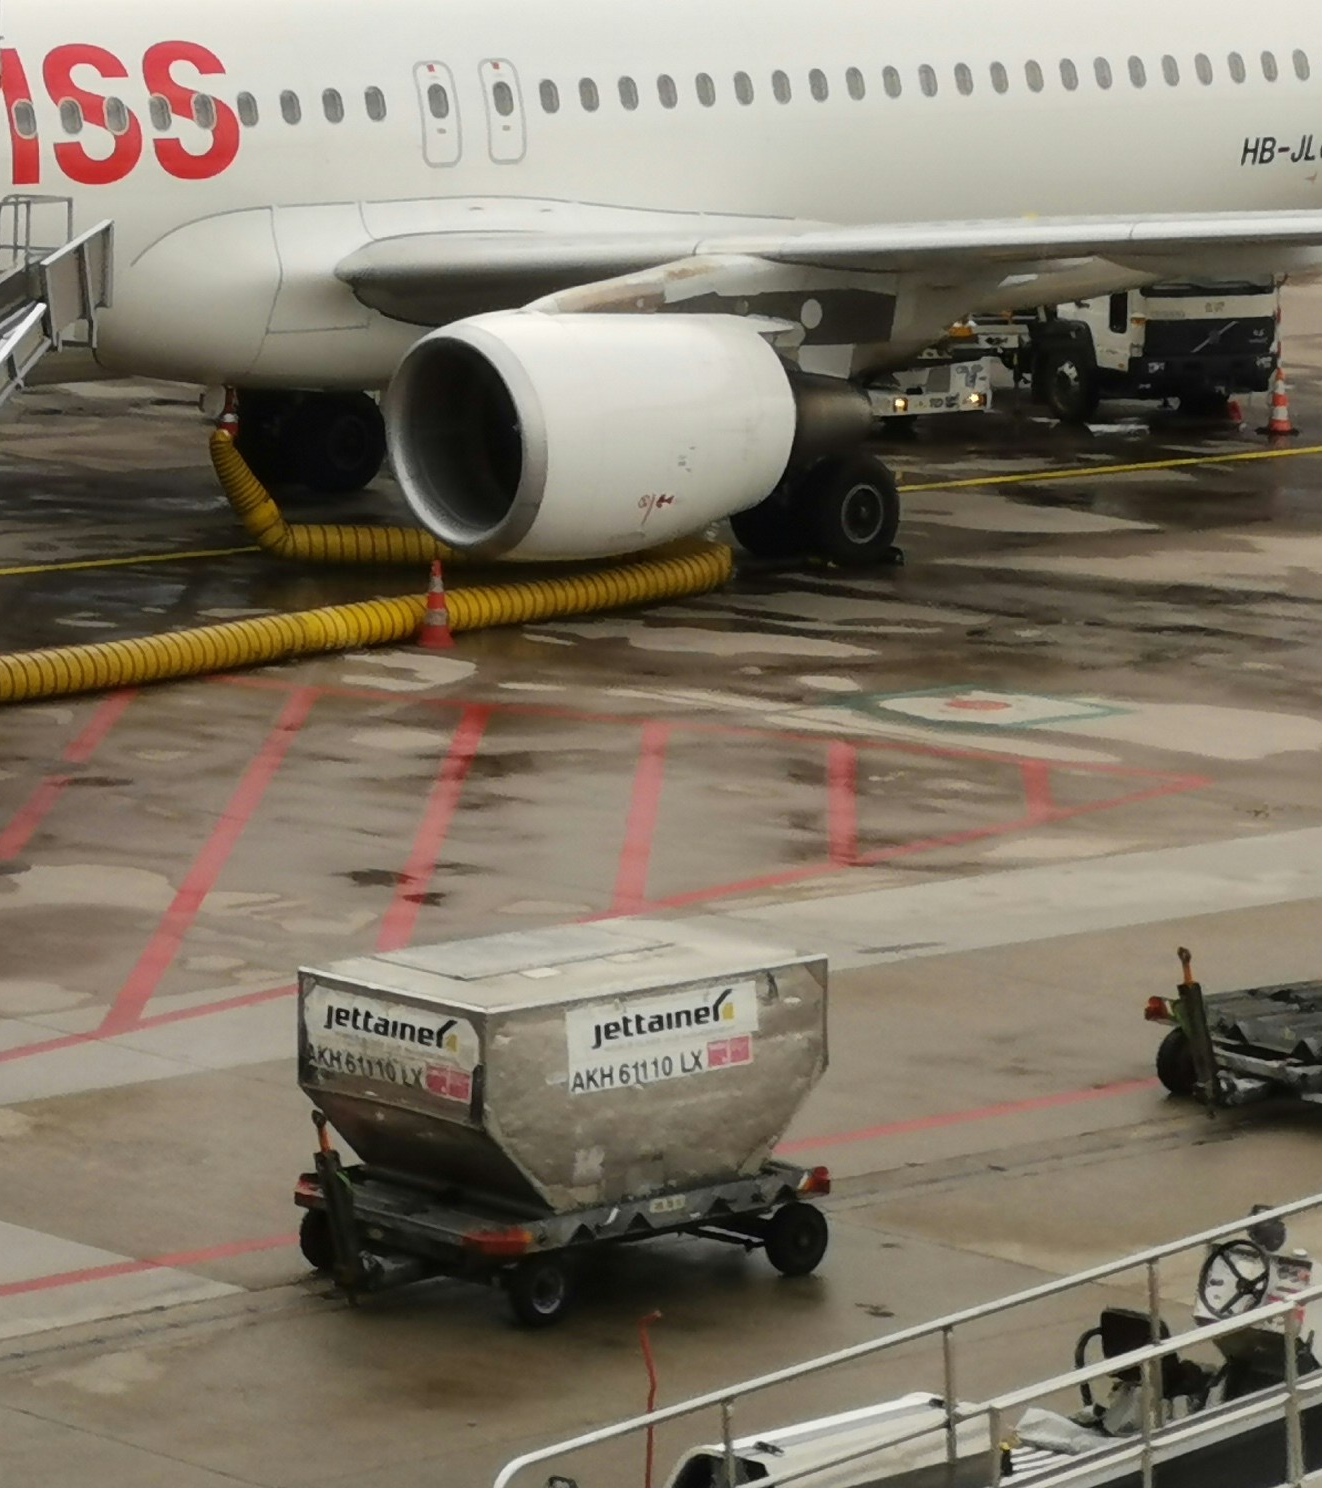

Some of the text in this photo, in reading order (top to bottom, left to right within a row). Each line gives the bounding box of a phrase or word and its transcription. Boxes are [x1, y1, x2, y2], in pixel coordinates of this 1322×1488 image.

[0, 40, 240, 185] ISS
[324, 1005, 458, 1049] jettainer
[592, 988, 733, 1049] jettainer
[401, 1067, 426, 1088] LX
[571, 1065, 615, 1093] AKH
[618, 1056, 673, 1084] 61110
[680, 1049, 704, 1074] LX
